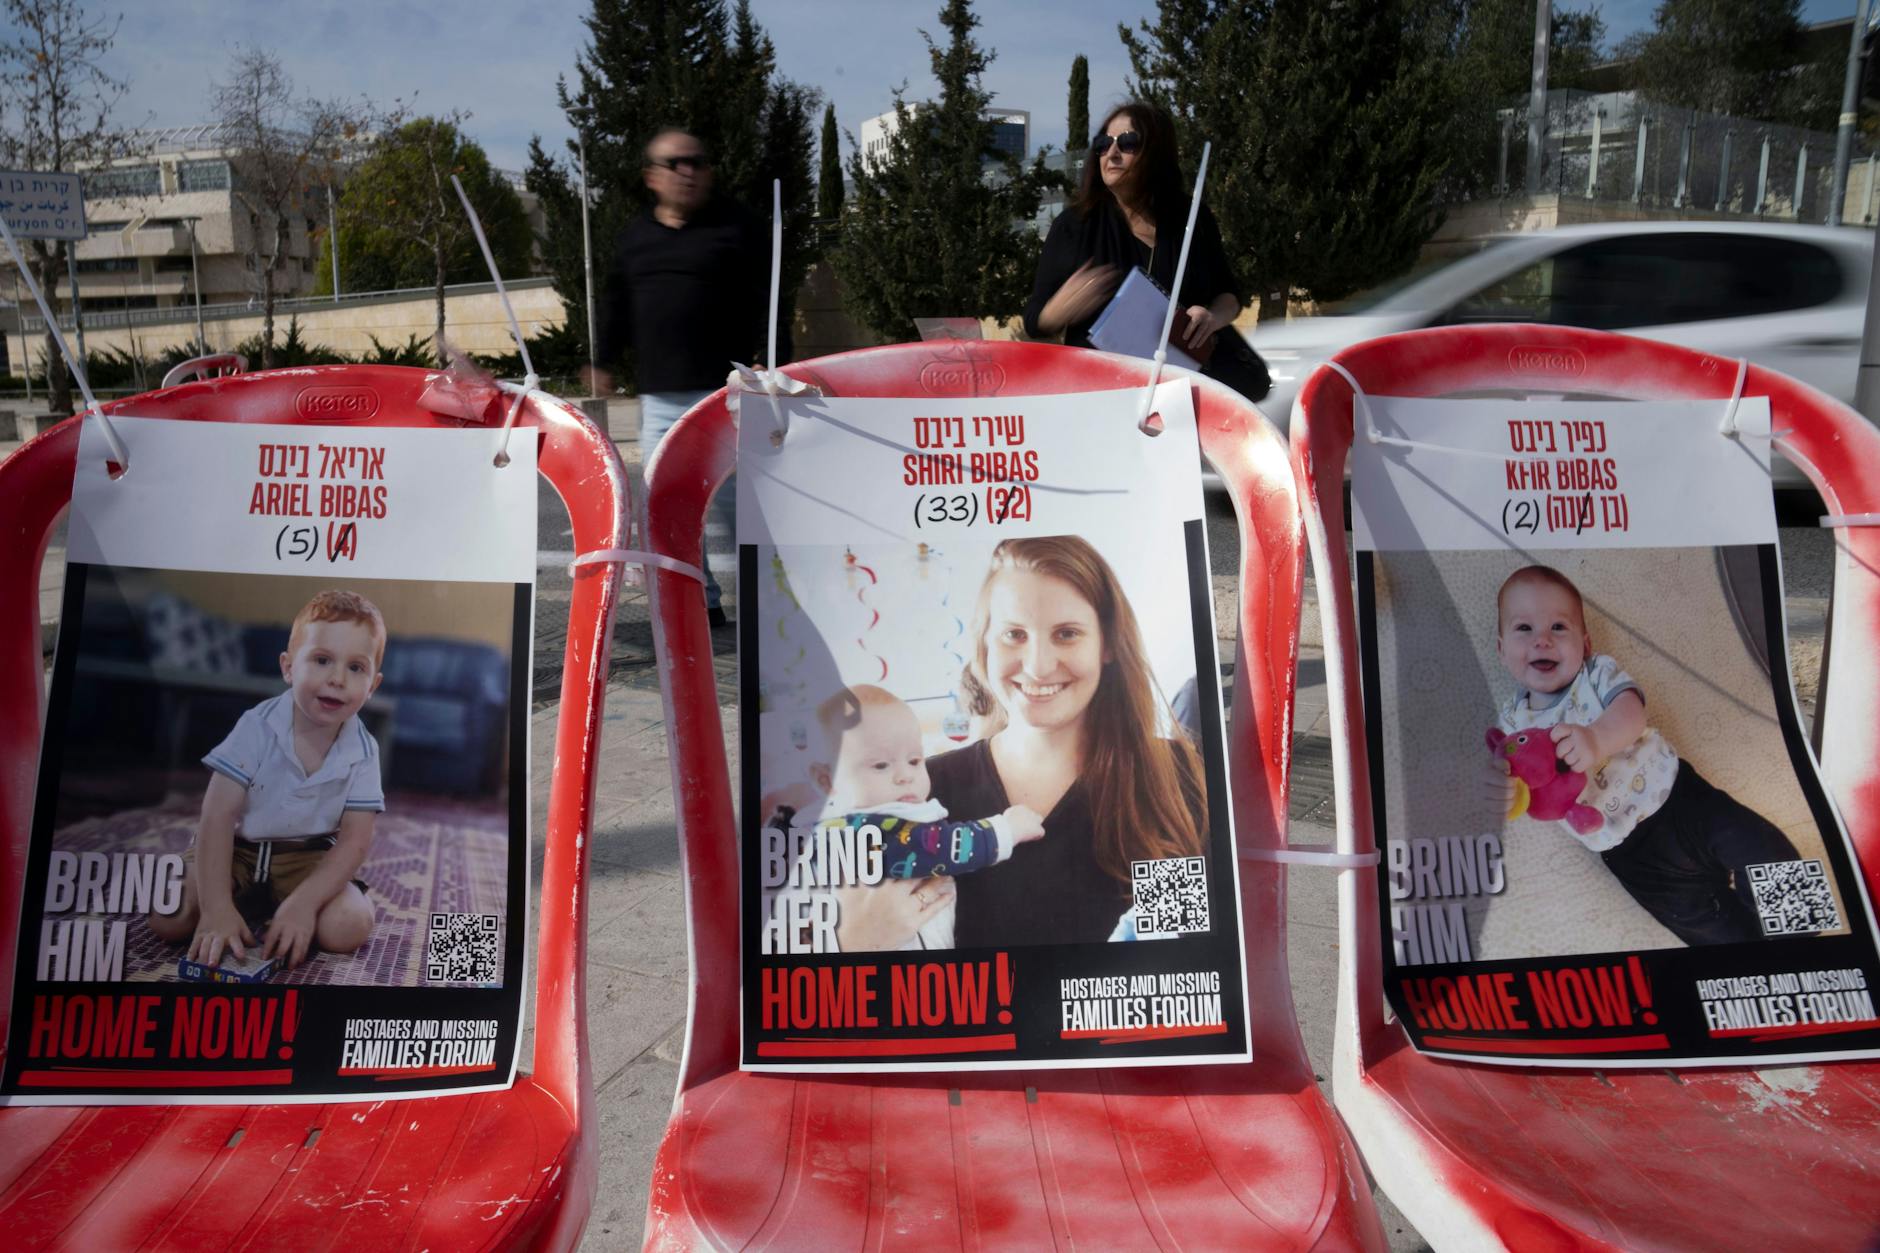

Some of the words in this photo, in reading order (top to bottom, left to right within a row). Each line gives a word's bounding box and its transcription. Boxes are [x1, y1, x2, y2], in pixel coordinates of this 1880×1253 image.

[10, 178, 24, 193] בן
[32, 180, 69, 197] קרית
[7, 219, 49, 231] uryon
[913, 416, 966, 449] ביבס
[972, 415, 1025, 447] שירי
[1507, 420, 1557, 453] ביבס
[1560, 421, 1607, 453] כפיר
[259, 444, 310, 478] ביבס
[318, 444, 385, 480] אריאל
[903, 453, 963, 486] SHIRI
[970, 450, 1039, 484] BIBAS
[1556, 458, 1618, 490] BIBAS
[249, 482, 313, 517] ARIEL
[319, 484, 387, 519] BIBAS
[914, 492, 979, 529] (33)
[986, 485, 1032, 524] (32)
[1502, 498, 1540, 535] (2)
[275, 525, 319, 562] (5)
[761, 824, 883, 888] BRING
[1388, 834, 1505, 899] BRING
[44, 850, 184, 915] BRING
[761, 892, 841, 955] HER
[1391, 903, 1472, 967] HIM
[36, 919, 127, 982] HIM
[762, 965, 878, 1030] HOME
[891, 952, 1015, 1027] NOW!
[1060, 976, 1128, 1000] HOSTAGES
[1130, 974, 1157, 996] AND
[1159, 971, 1220, 995] MISSING
[1400, 972, 1529, 1031] HOME
[1527, 956, 1659, 1029] NOW!
[1696, 975, 1770, 1000] HOSTAGES
[1769, 973, 1800, 995] AND
[1798, 968, 1867, 993] MISSING
[28, 994, 162, 1059] HOME
[168, 989, 299, 1061] NOW!
[1061, 997, 1147, 1031] FAMILIES
[1151, 994, 1223, 1028] FORUM
[1702, 995, 1797, 1031] FAMILIES
[1796, 990, 1877, 1025] FORUM
[345, 1019, 411, 1040] HOSTAGES
[412, 1019, 440, 1040] AND
[441, 1019, 498, 1040] MISSING
[341, 1039, 427, 1069] FAMILIES
[428, 1039, 496, 1068] FORUM
